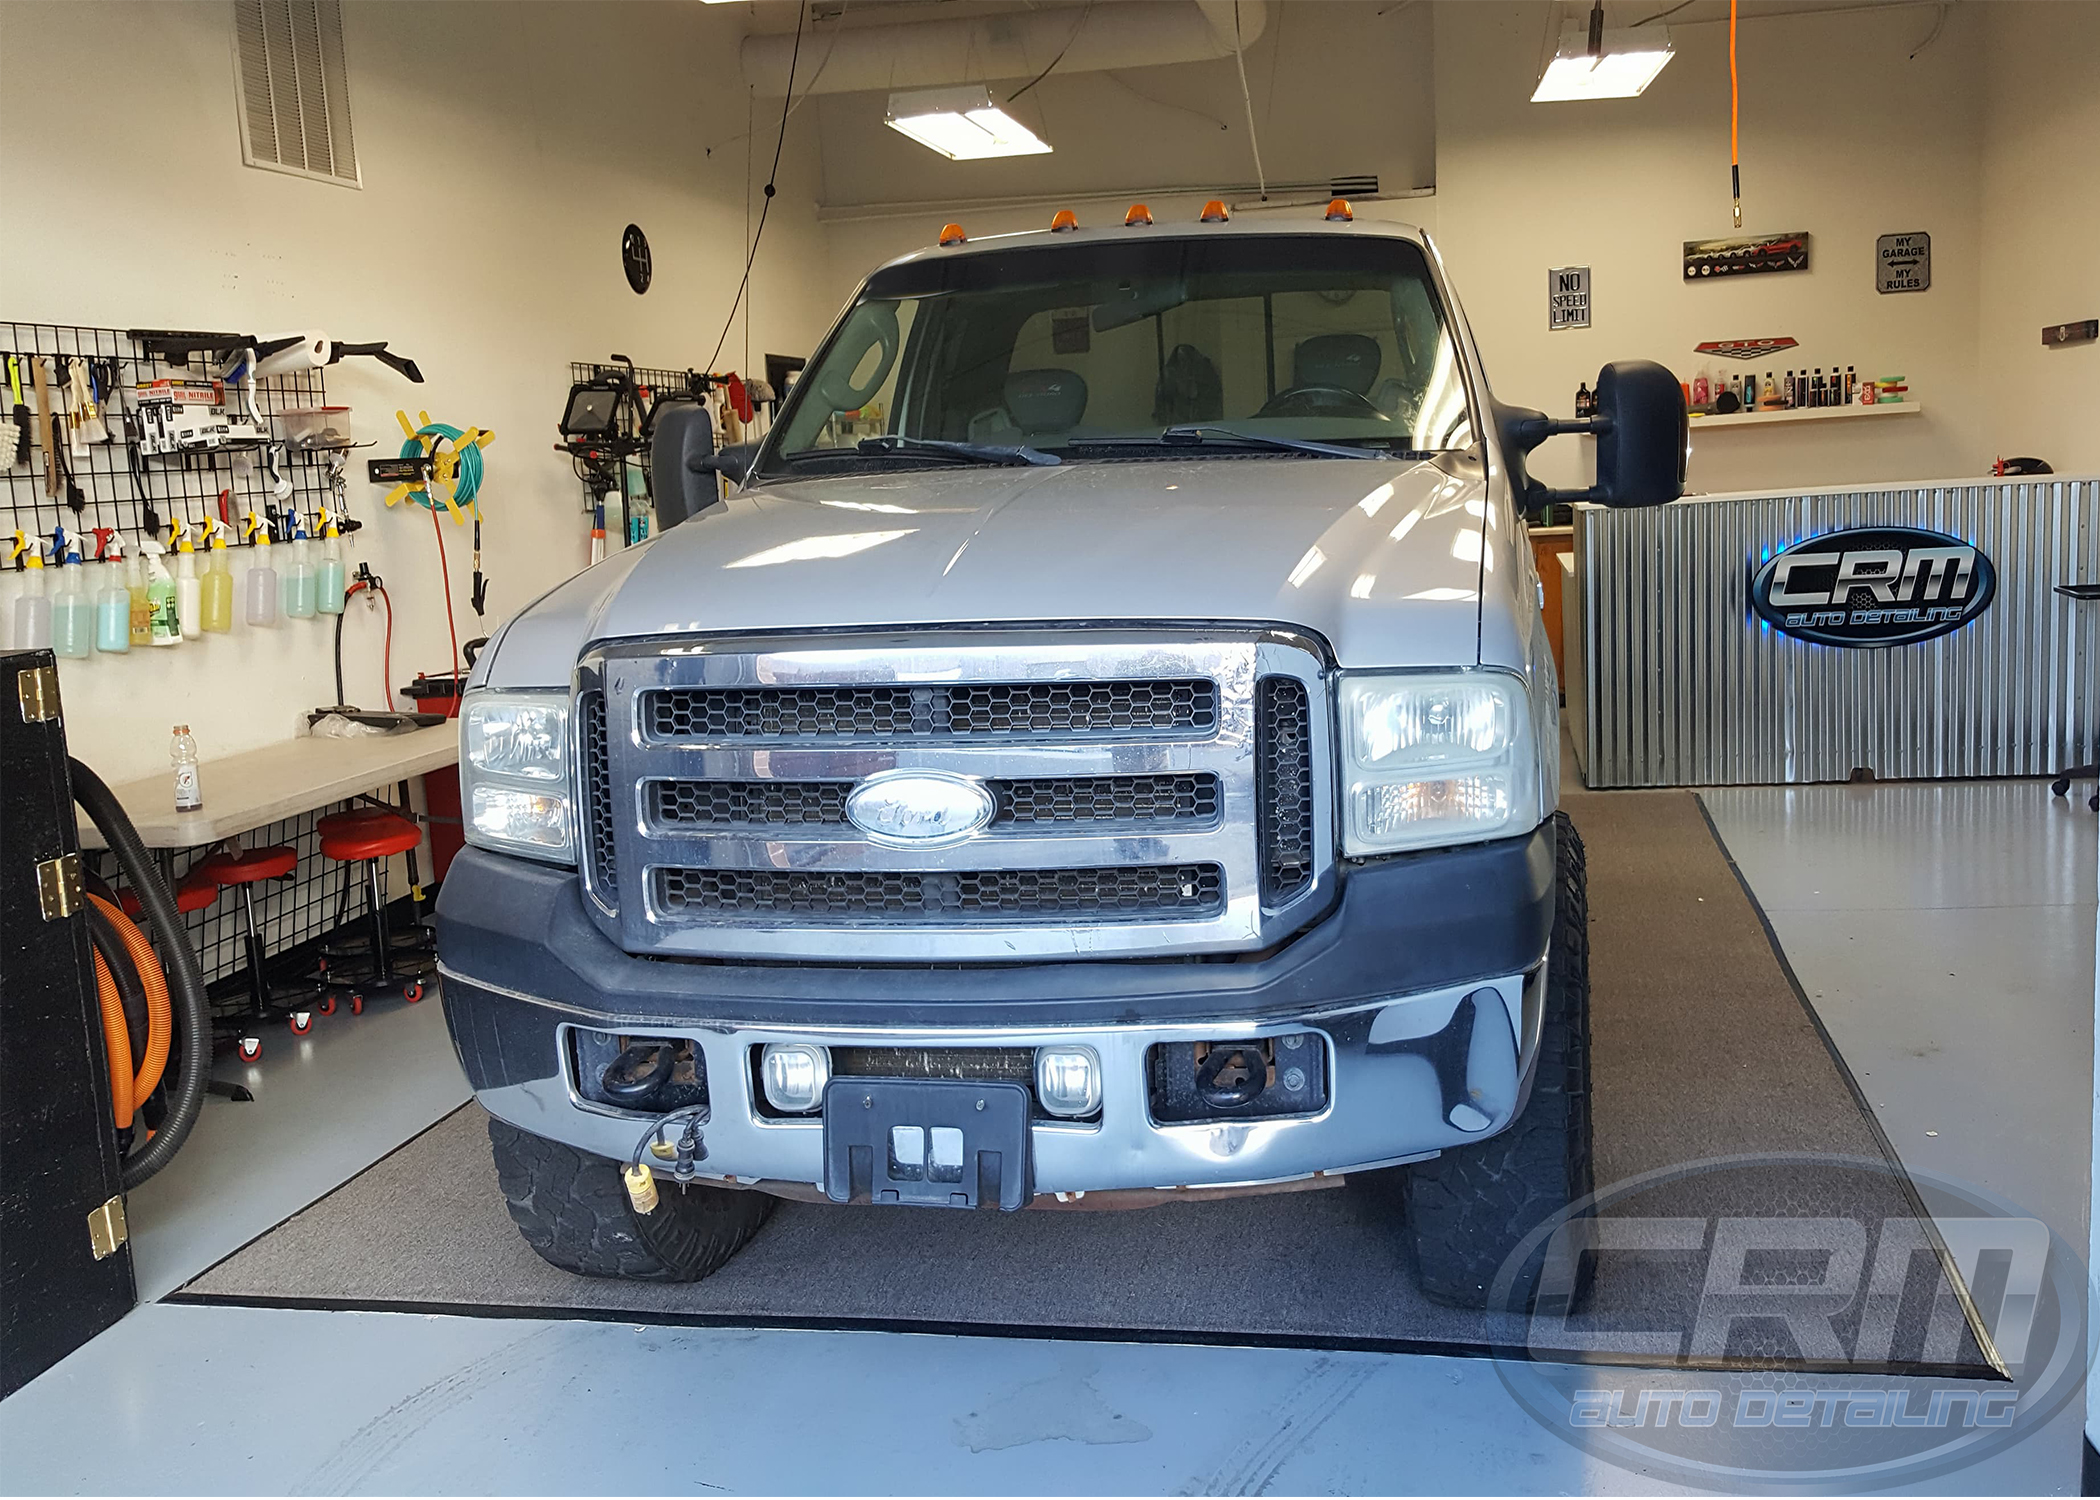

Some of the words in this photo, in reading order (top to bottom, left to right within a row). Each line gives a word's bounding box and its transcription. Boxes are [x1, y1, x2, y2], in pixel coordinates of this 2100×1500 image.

[1895, 237, 1912, 247] MY
[1882, 247, 1925, 258] GARAGE
[1895, 269, 1912, 279] MY
[1559, 272, 1580, 292] NO
[1886, 279, 1920, 290] RULES
[1553, 294, 1587, 307] SPEED
[1553, 308, 1586, 323] LIMIT
[1718, 339, 1775, 348] GTO
[149, 388, 170, 397] NITRILE
[188, 391, 214, 400] NITRILE
[1769, 546, 1975, 606] CRM
[1785, 611, 1846, 628] AUTO
[1849, 606, 1963, 625] DETAILING
